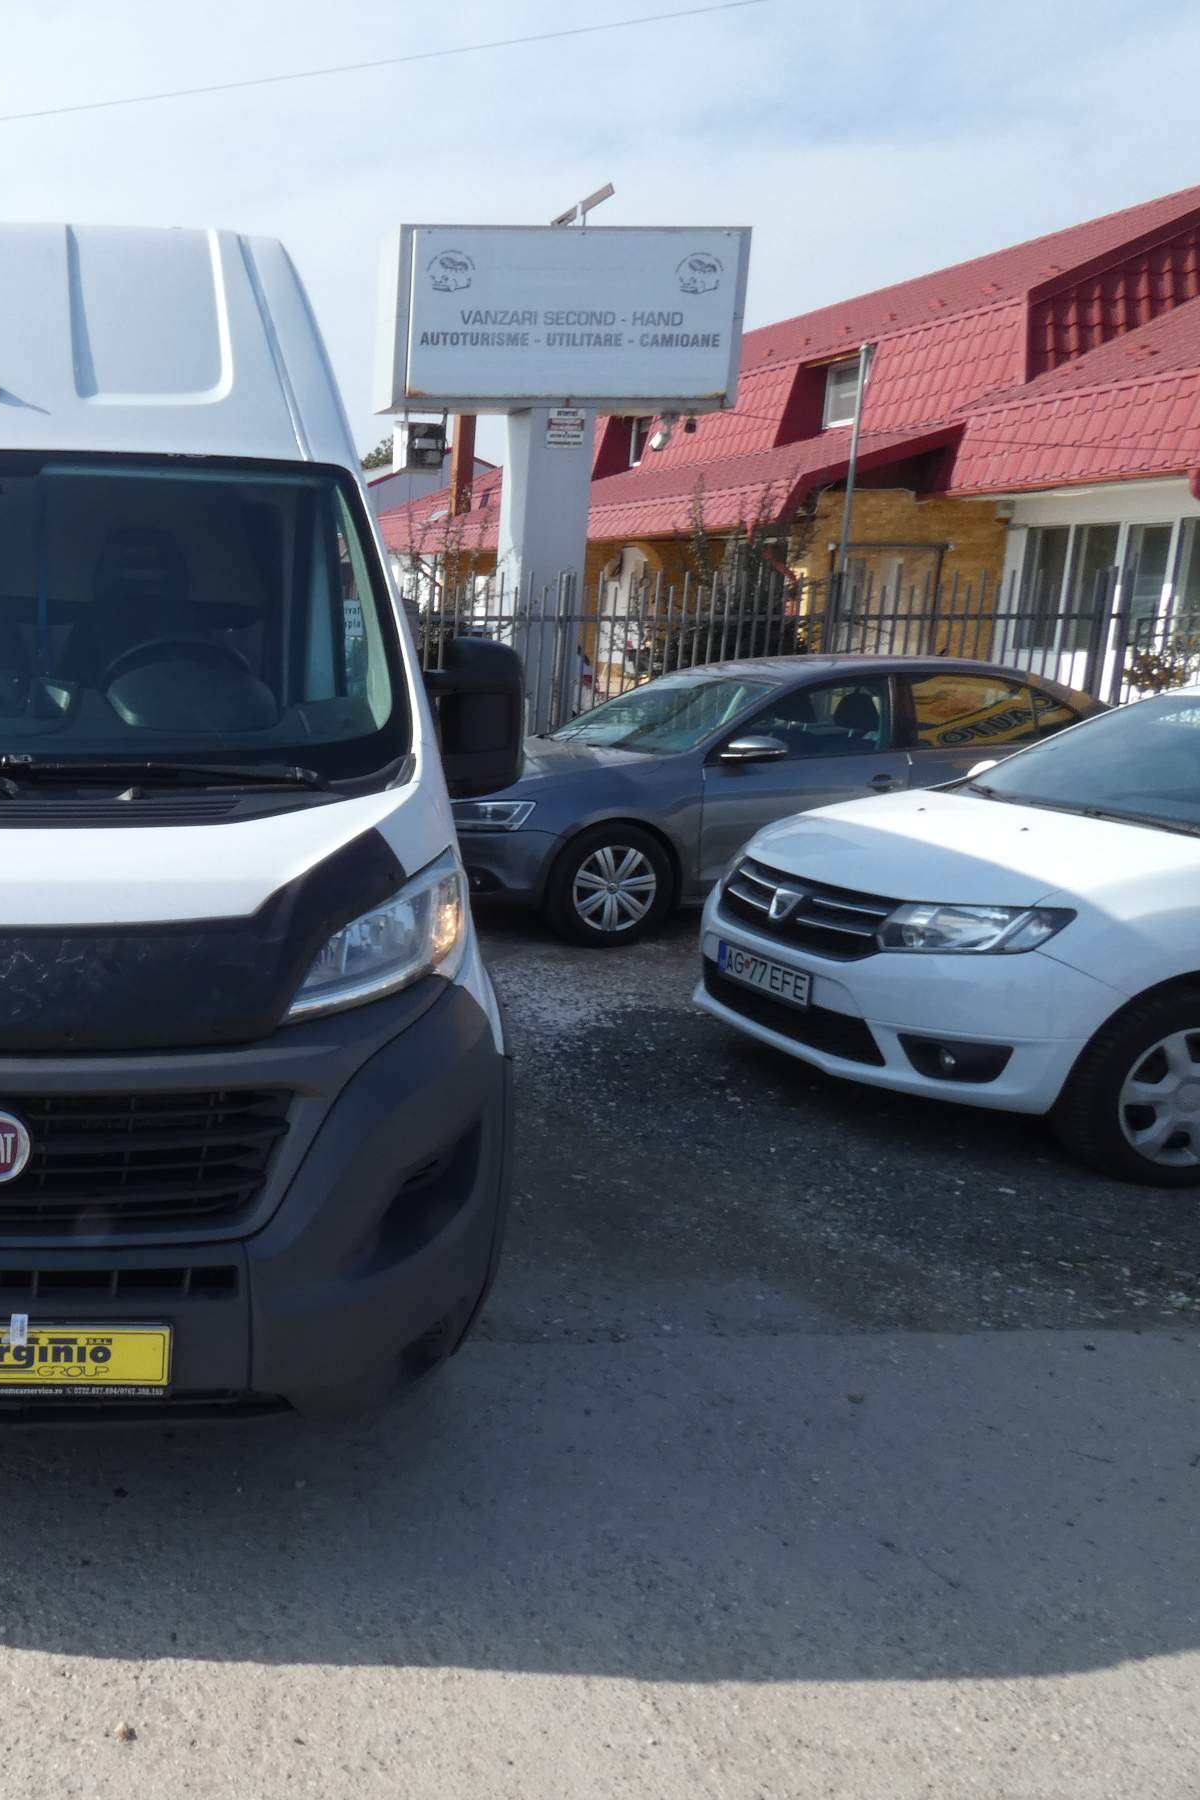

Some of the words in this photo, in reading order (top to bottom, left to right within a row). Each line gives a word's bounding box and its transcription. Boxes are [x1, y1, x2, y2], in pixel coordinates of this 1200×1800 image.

[460, 310, 537, 326] VANZARI
[543, 311, 616, 326] SECOND
[632, 311, 684, 327] HAND
[420, 332, 529, 346] AUTOTURISME
[546, 333, 623, 347] UTILITARE
[639, 333, 721, 348] CAMIOANE
[727, 948, 745, 974] AG
[749, 957, 768, 983] 77
[769, 966, 807, 1001] EFE
[36, 1365, 110, 1378] GROUP
